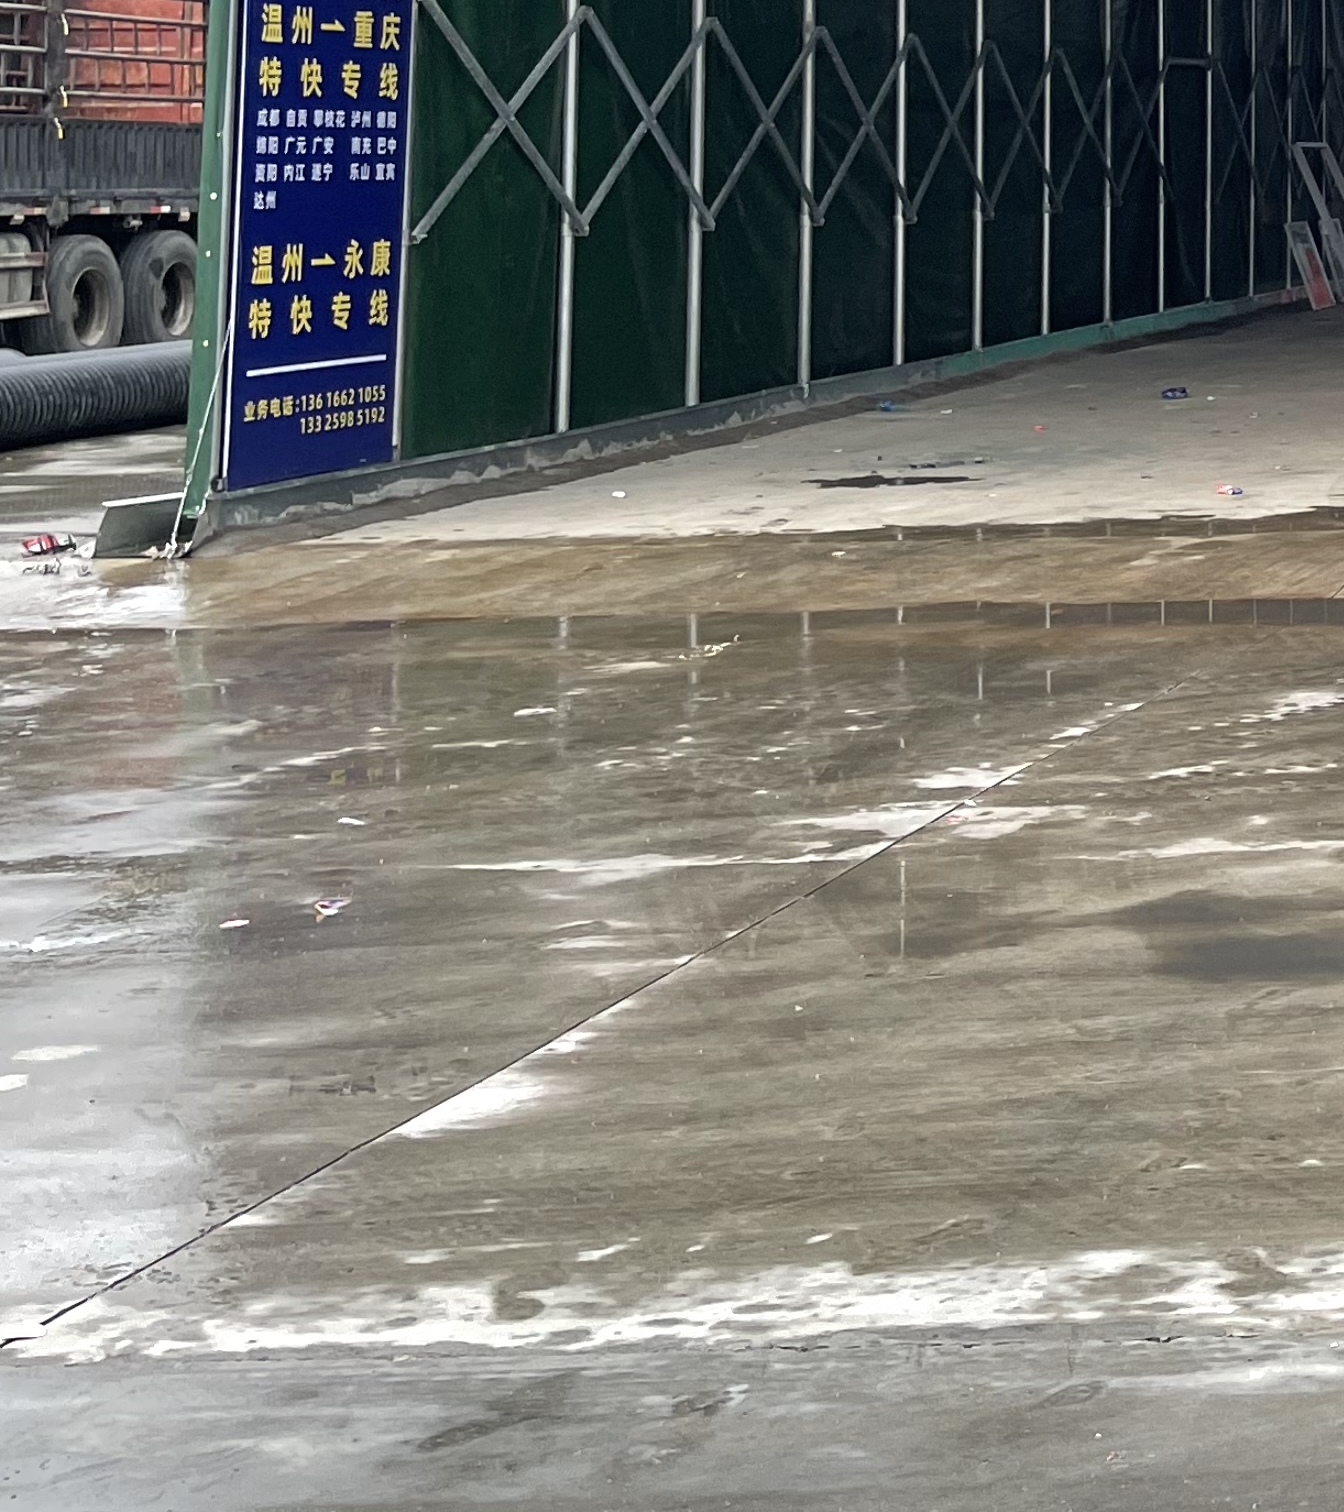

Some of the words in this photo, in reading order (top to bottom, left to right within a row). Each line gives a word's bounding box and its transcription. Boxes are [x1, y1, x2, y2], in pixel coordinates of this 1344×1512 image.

[261, 3, 313, 45] 温州
[353, 10, 401, 51] 重庆
[259, 56, 399, 101] 特快专线
[251, 243, 303, 285] 温州
[343, 238, 391, 280] 永康
[248, 289, 389, 340] 特快专线
[327, 388, 354, 408] 1662
[358, 385, 386, 404] 1055
[300, 416, 321, 434] 133
[325, 410, 354, 430] 2598
[357, 407, 385, 424] 5192
